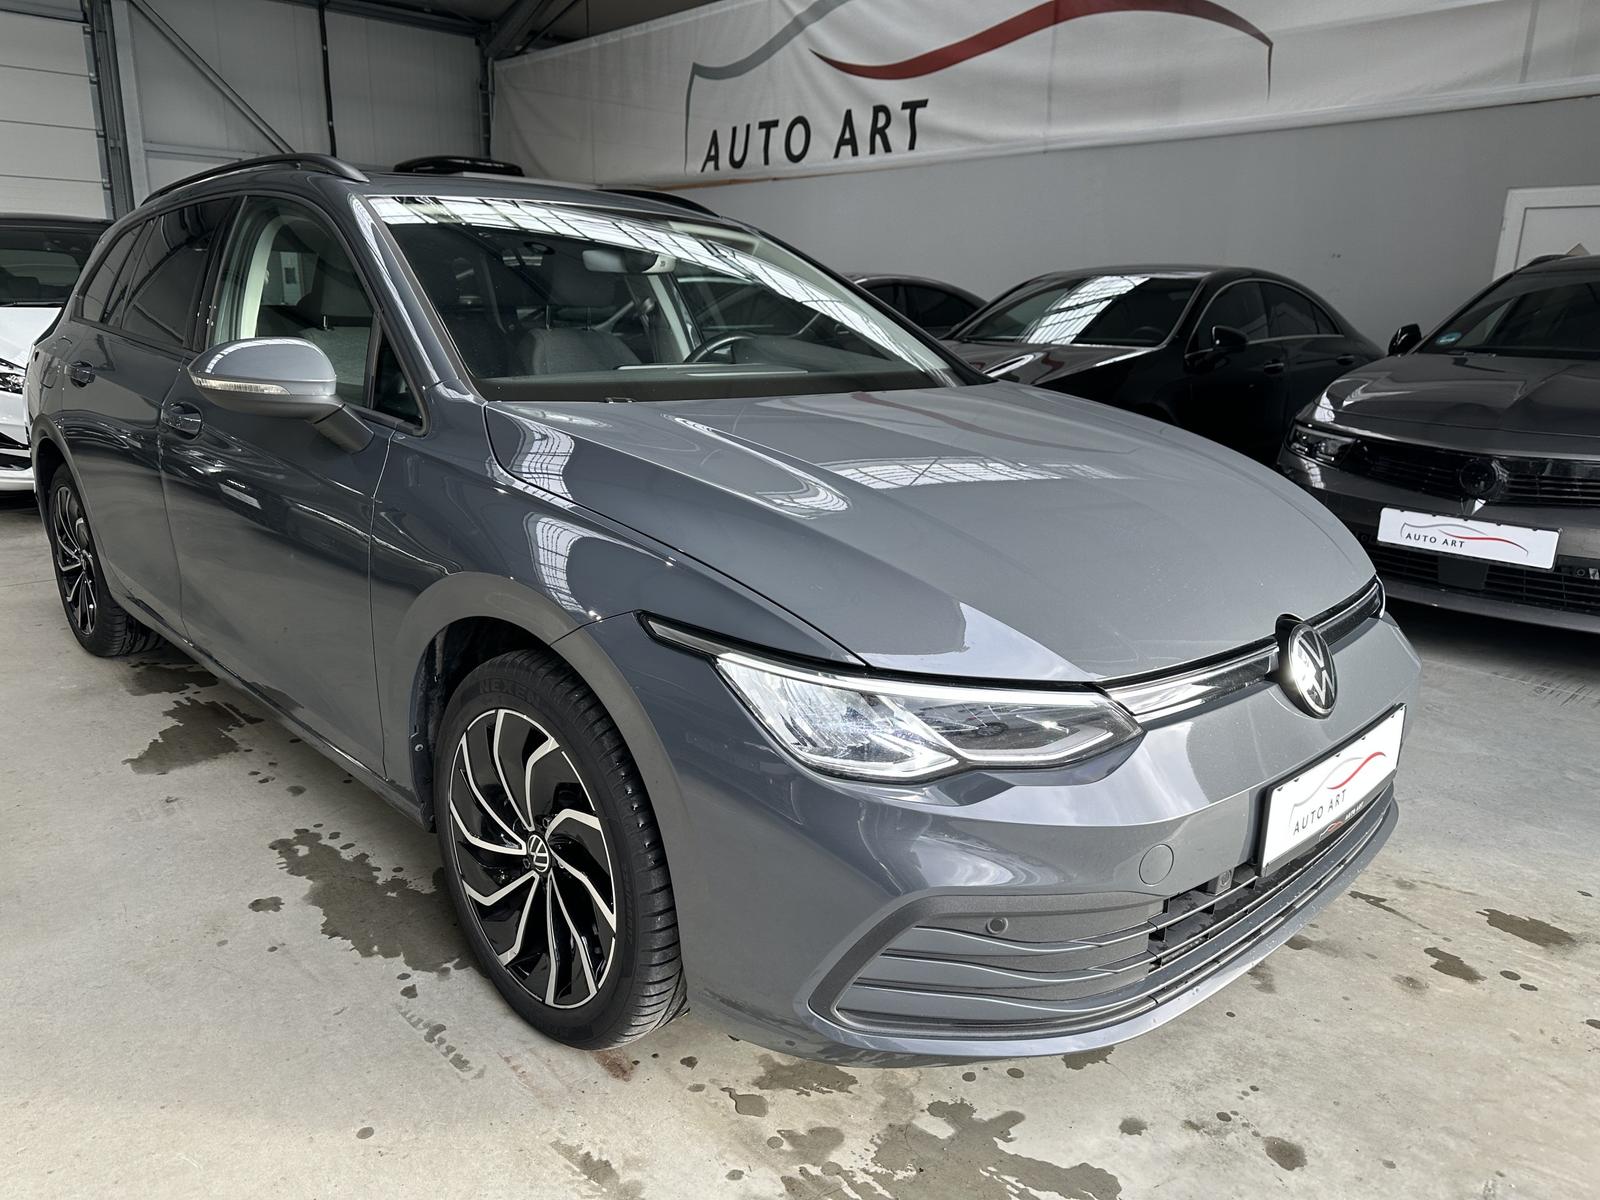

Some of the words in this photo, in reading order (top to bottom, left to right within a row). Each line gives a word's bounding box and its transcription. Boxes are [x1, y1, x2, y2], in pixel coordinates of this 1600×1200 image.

[701, 115, 811, 172] AUTO
[833, 98, 929, 159] ART
[1405, 532, 1437, 544] AUTO
[1441, 538, 1465, 548] ART
[1293, 805, 1324, 836] AUTO
[1328, 789, 1346, 813] ART
